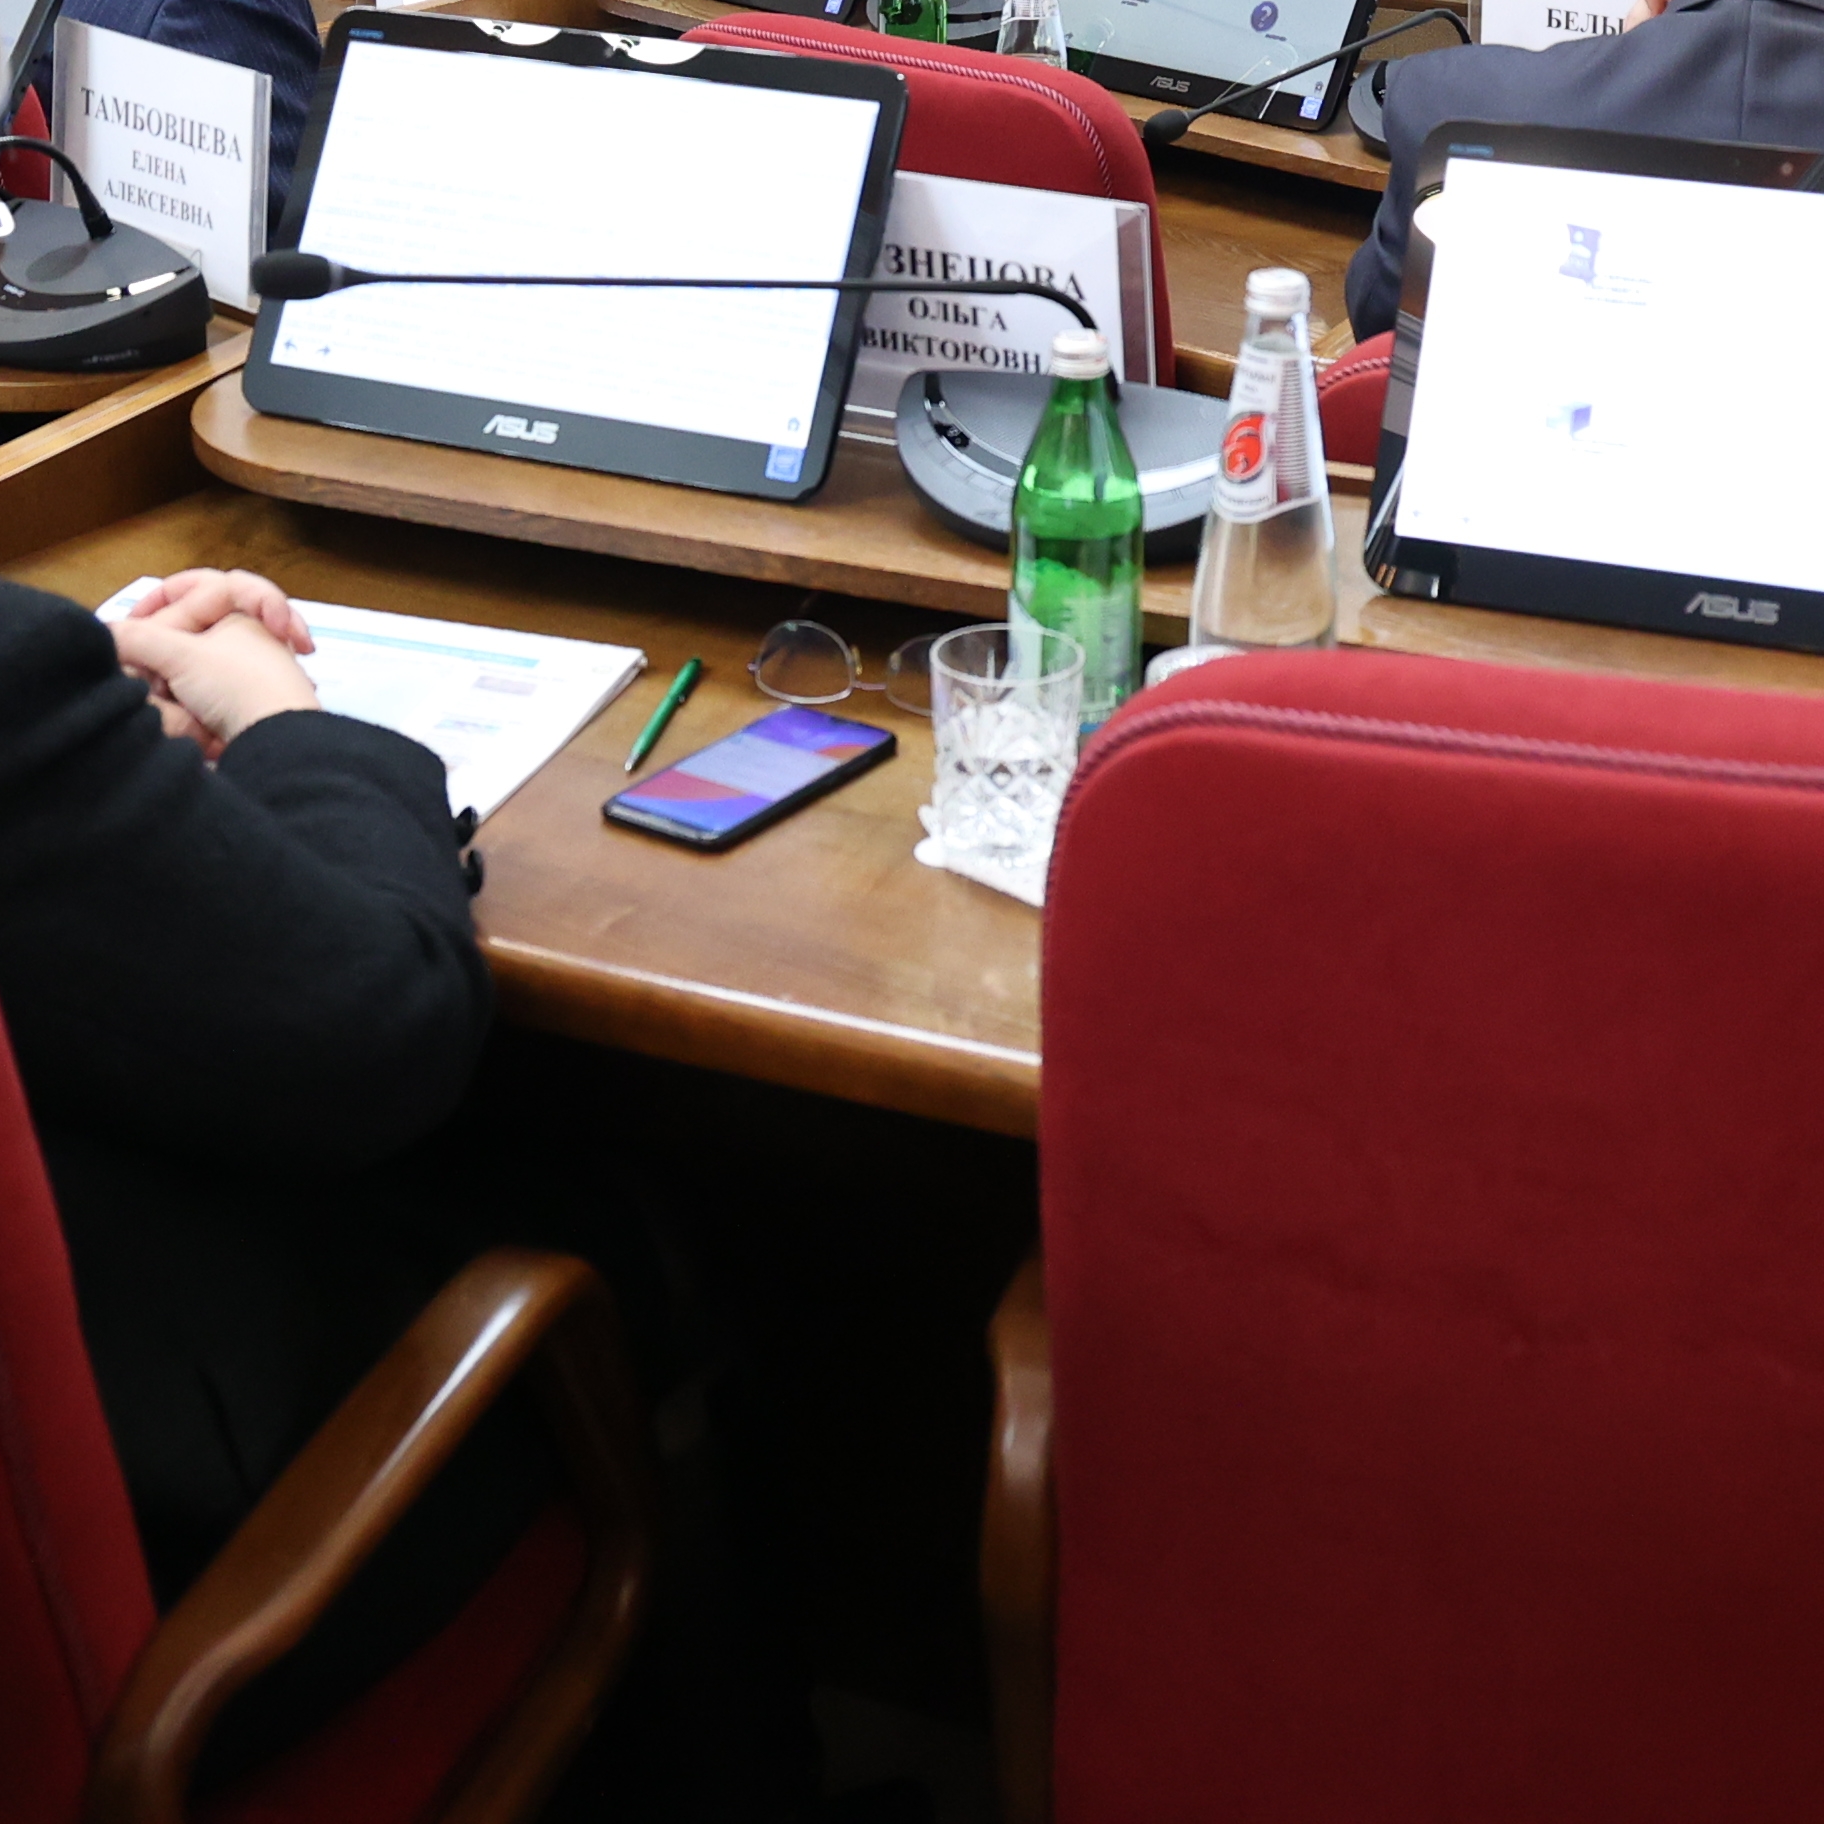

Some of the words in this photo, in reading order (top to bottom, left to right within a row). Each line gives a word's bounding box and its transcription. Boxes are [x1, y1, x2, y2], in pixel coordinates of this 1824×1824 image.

[1546, 7, 1625, 36] БЕЛЫ
[1150, 76, 1191, 93] ASUS
[81, 86, 243, 163] ТАМБОВЦЕВА
[132, 150, 187, 186] ЕЛЕНА
[104, 179, 214, 230] АЛЕКСЕЕВНА
[885, 244, 1087, 301] ЗНЕЦОВА
[908, 296, 1008, 332] ОЛЬГА
[863, 328, 1048, 375] ВИКТОРОВН
[482, 414, 560, 444] ASUS
[1684, 591, 1780, 625] ASUS
